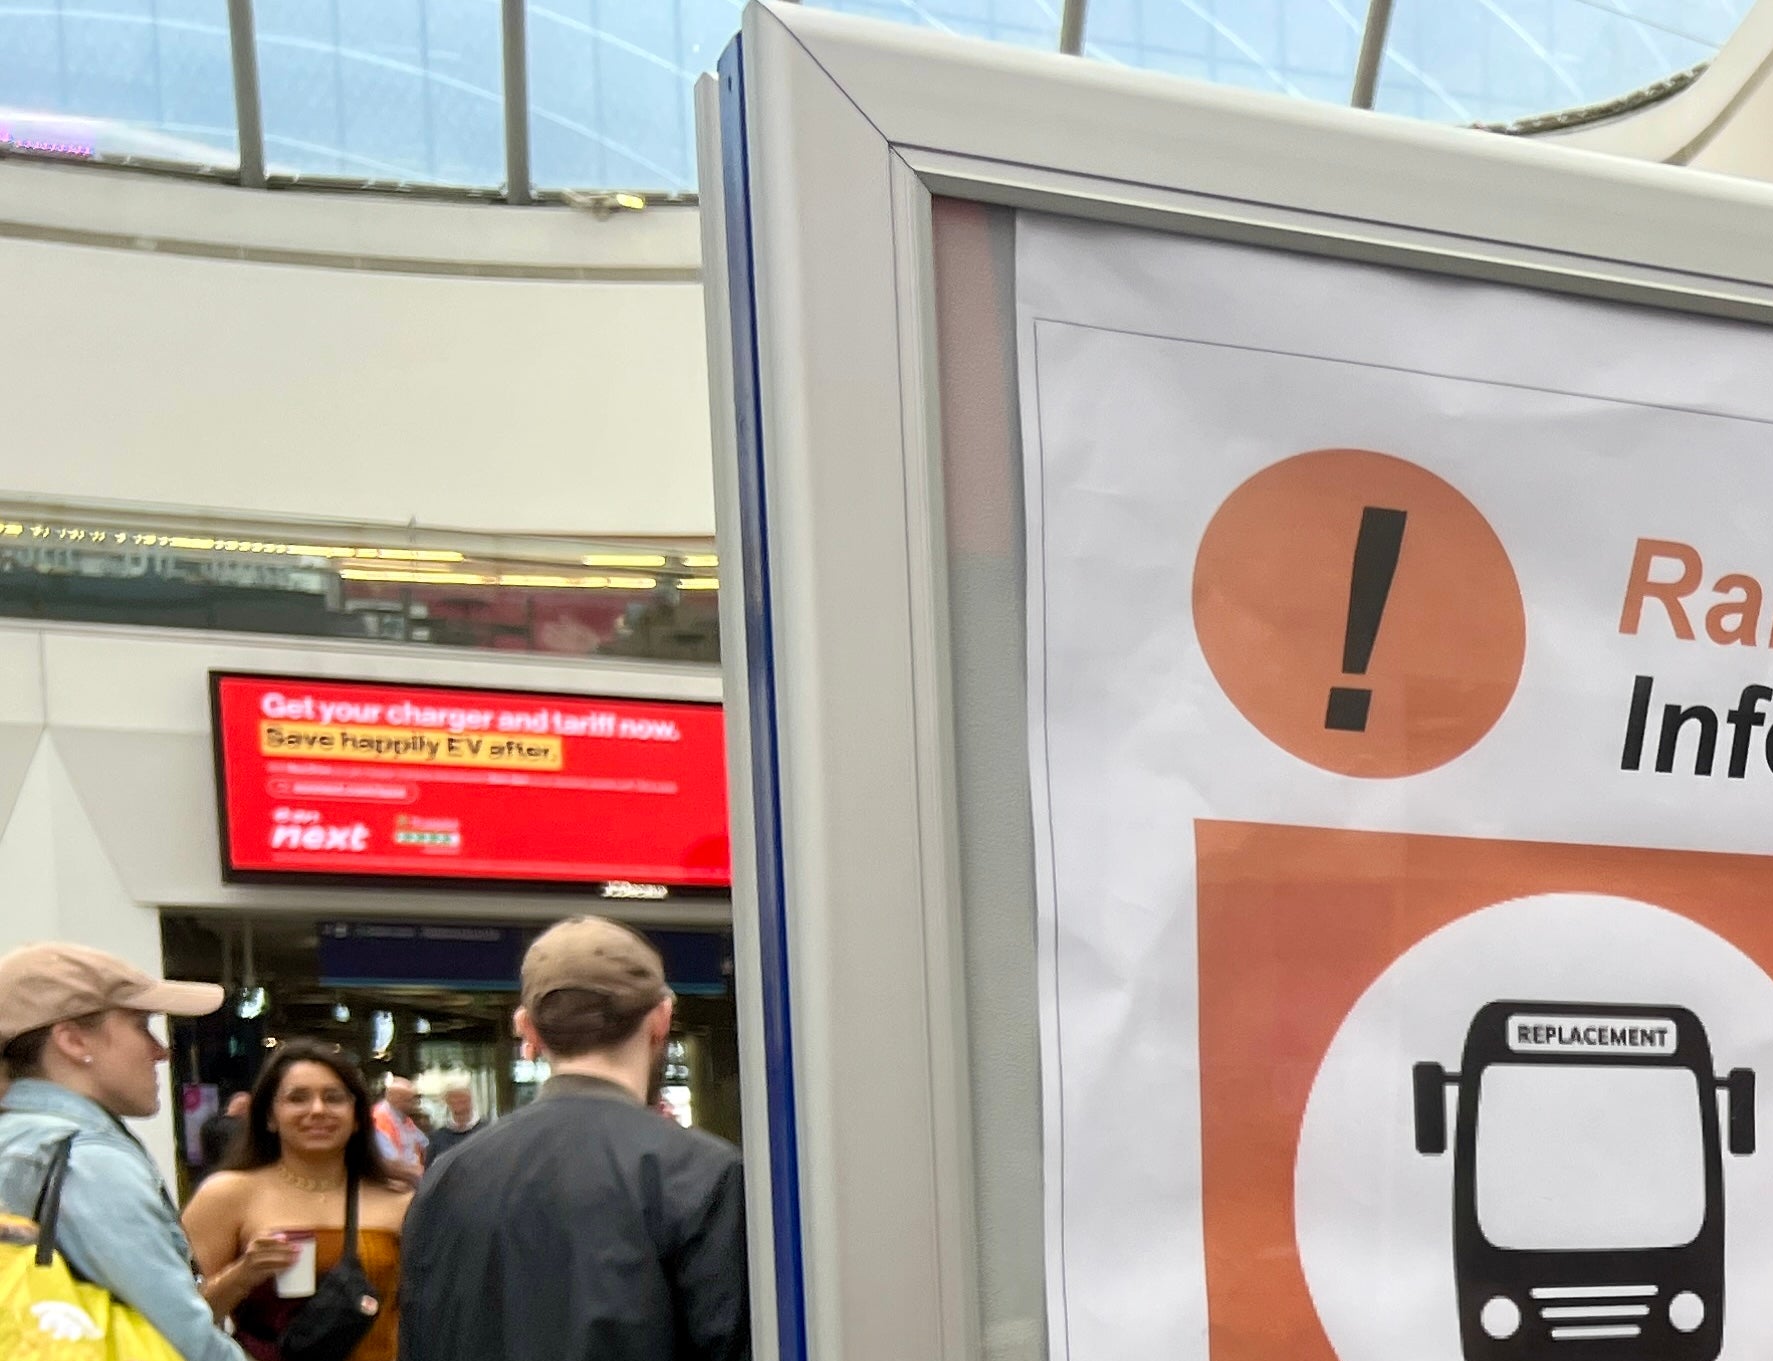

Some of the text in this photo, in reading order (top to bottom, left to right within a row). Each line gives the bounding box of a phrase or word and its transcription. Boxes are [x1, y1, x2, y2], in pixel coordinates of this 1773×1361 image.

[262, 692, 315, 719] Get
[319, 700, 382, 724] your
[386, 702, 491, 732] charger
[498, 708, 549, 733] and
[552, 711, 616, 737] tariff
[266, 727, 335, 748] Save
[340, 731, 439, 761] happily
[447, 736, 483, 757] EV
[271, 823, 370, 852] next
[1517, 1023, 1668, 1047] REPLACEMENT
